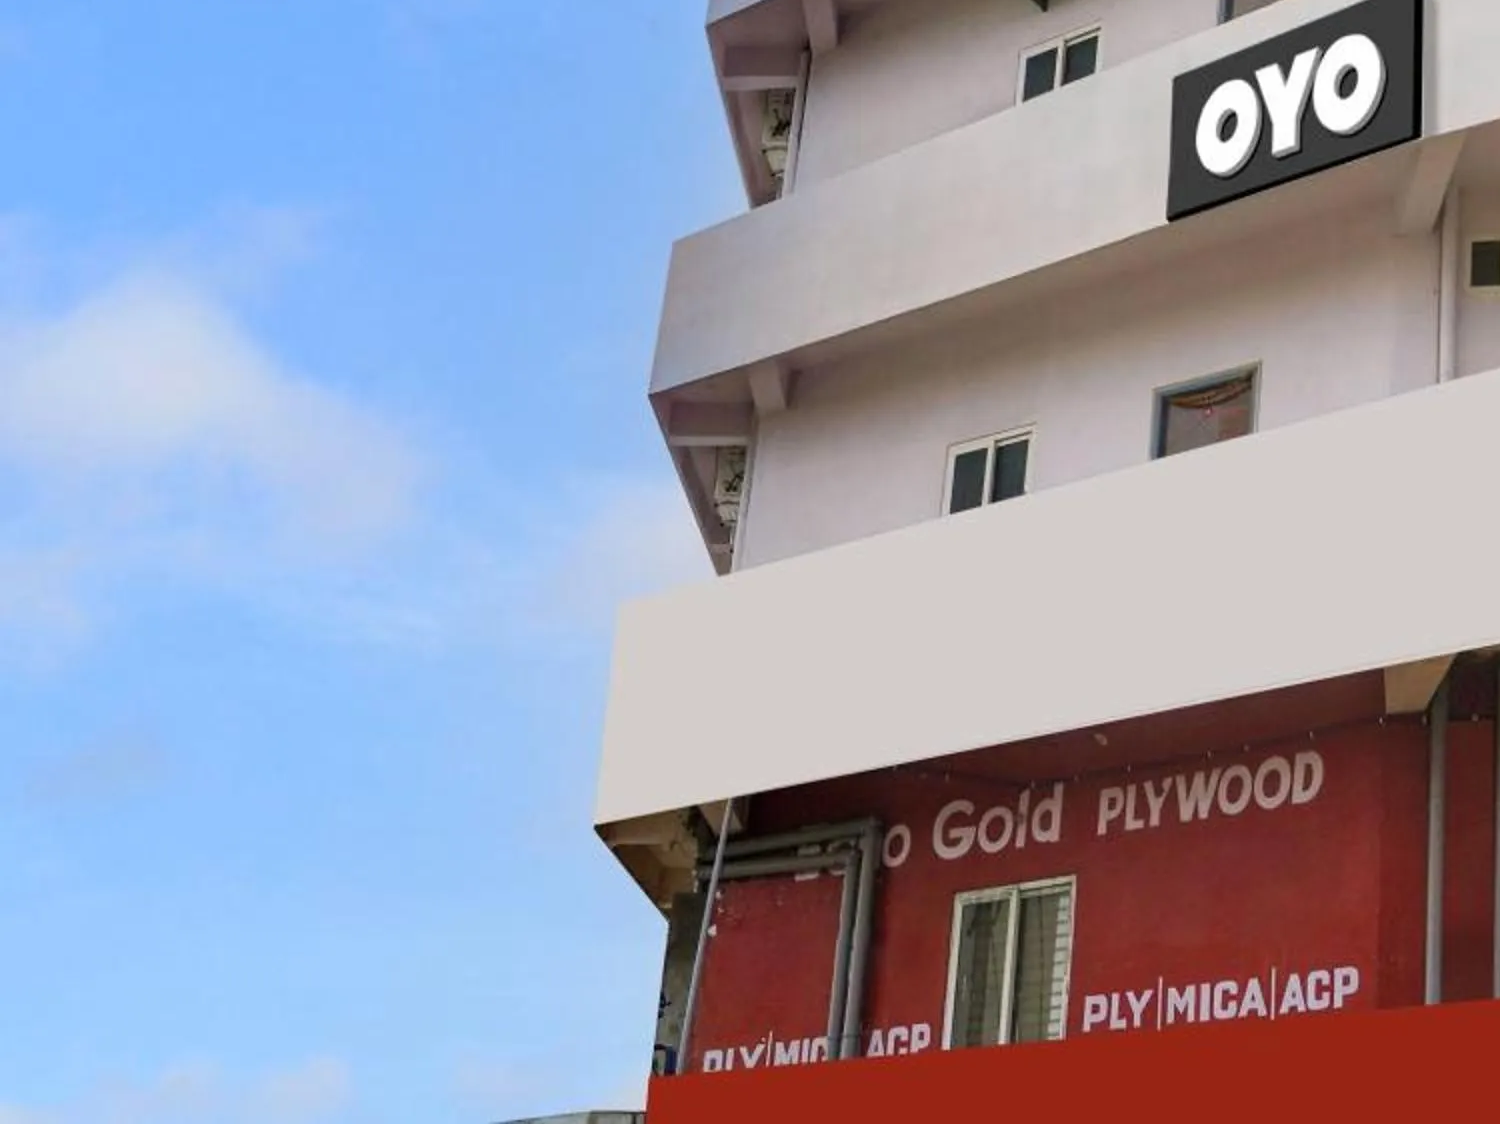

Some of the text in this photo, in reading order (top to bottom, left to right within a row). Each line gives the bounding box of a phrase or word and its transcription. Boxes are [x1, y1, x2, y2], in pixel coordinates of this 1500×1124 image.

[1195, 33, 1386, 177] OYO
[932, 781, 1063, 860] Gold
[1096, 750, 1325, 836] PLYWOOD
[1081, 966, 1360, 1033] PLY MICA ACP
